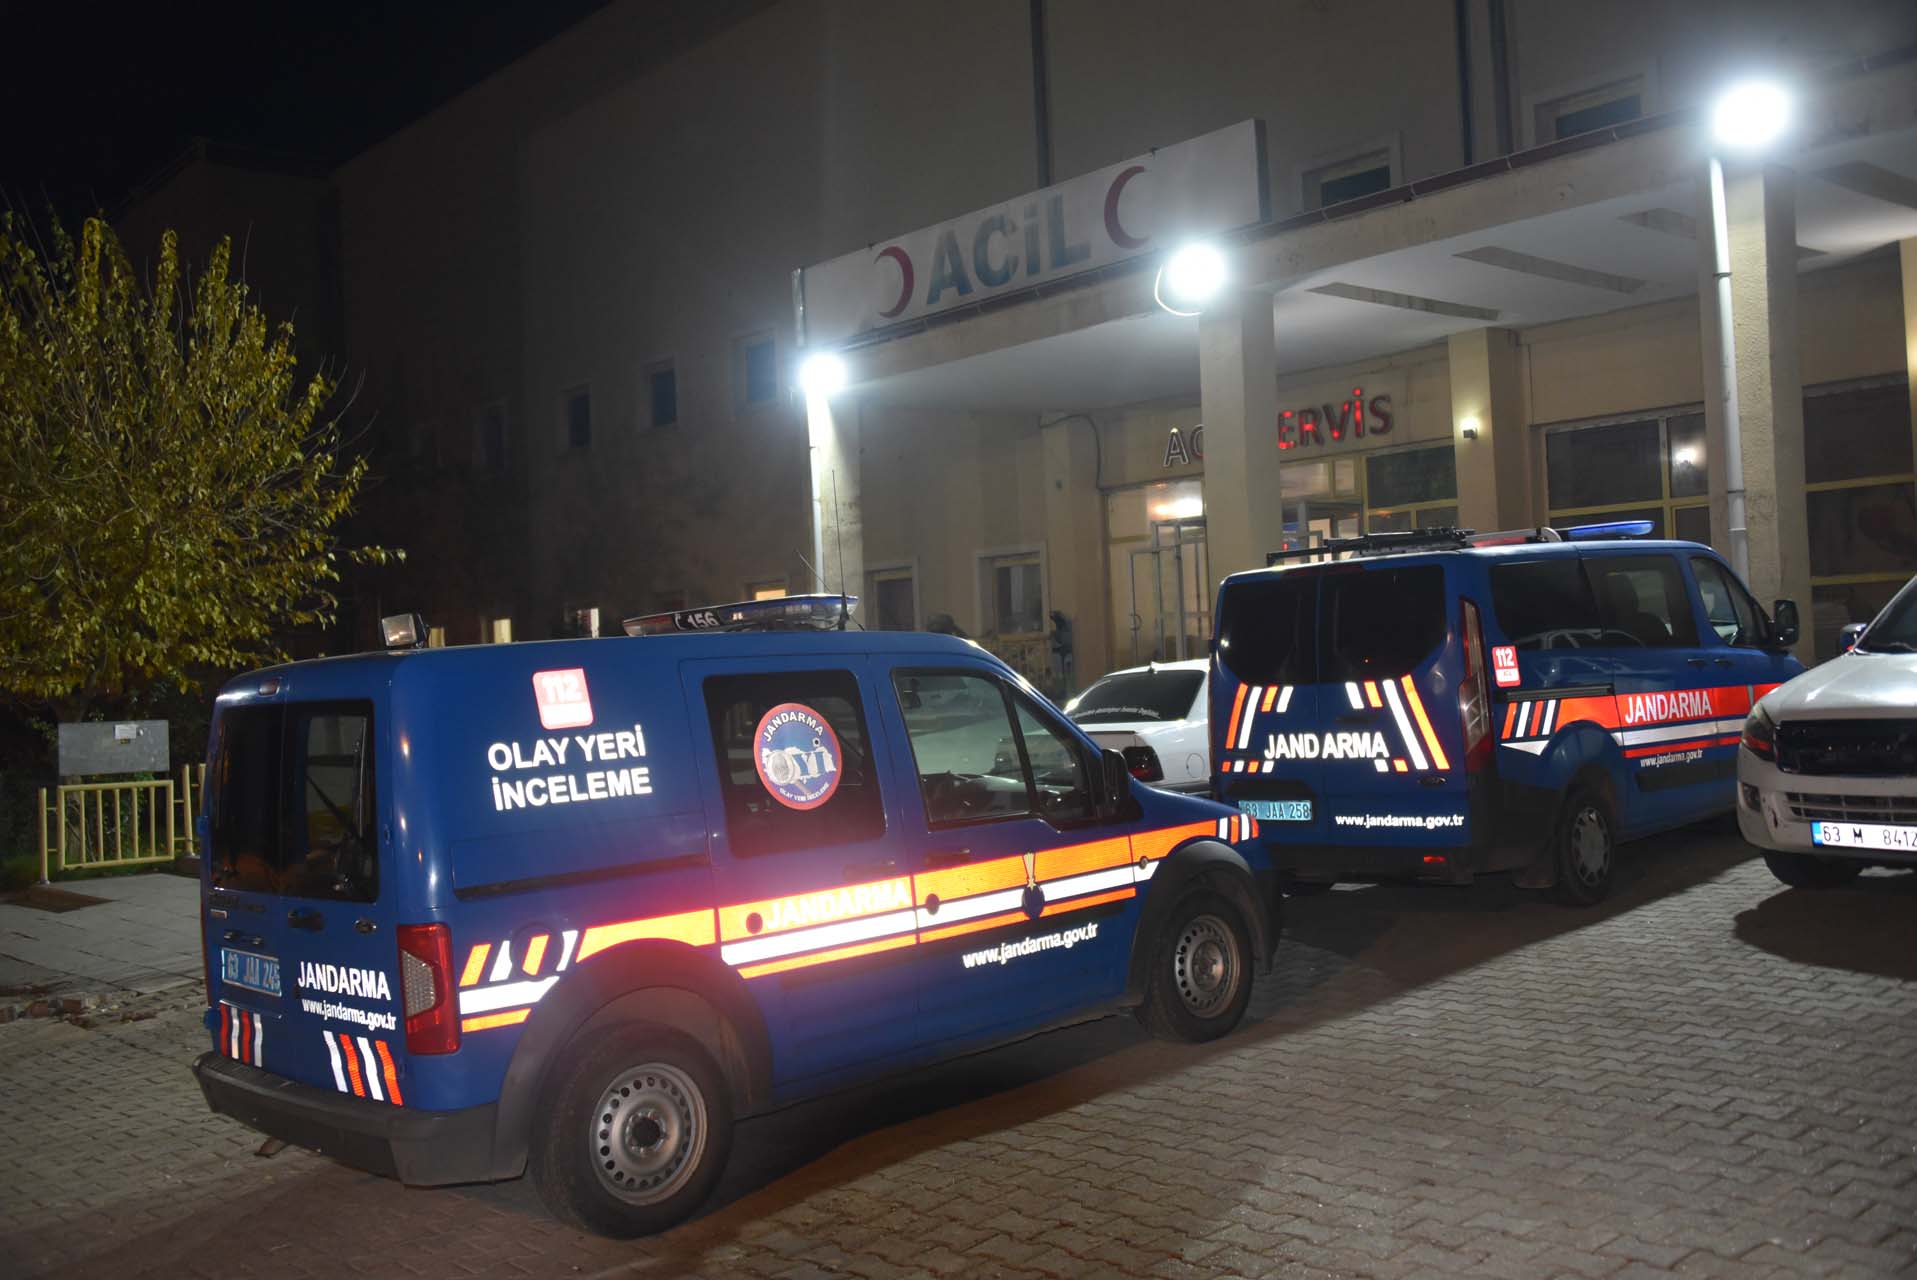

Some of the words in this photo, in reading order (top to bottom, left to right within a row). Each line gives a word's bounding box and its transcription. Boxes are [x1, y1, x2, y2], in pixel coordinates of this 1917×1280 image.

[1277, 388, 1393, 450] ERVİS
[687, 611, 720, 629] 156
[1495, 647, 1515, 667] 112
[541, 674, 583, 704] 112
[1625, 691, 1712, 724] JANDARMA
[763, 711, 824, 742] JANDARMA
[487, 737, 569, 771] OLAY
[575, 723, 646, 762] YERİ
[1264, 732, 1390, 760] JANDARMA
[491, 766, 653, 811] İNCELEME
[1289, 803, 1310, 819] 258
[1335, 813, 1465, 829] www.jandarma.gov.tr
[1823, 826, 1841, 843] 63
[1852, 827, 1864, 844] M
[766, 878, 911, 929] JANDARMA
[962, 922, 1100, 969] www.jandarma.gov.tr
[297, 961, 391, 1001] JANDARMA
[302, 998, 397, 1031] www.jandarma.gov.tr
